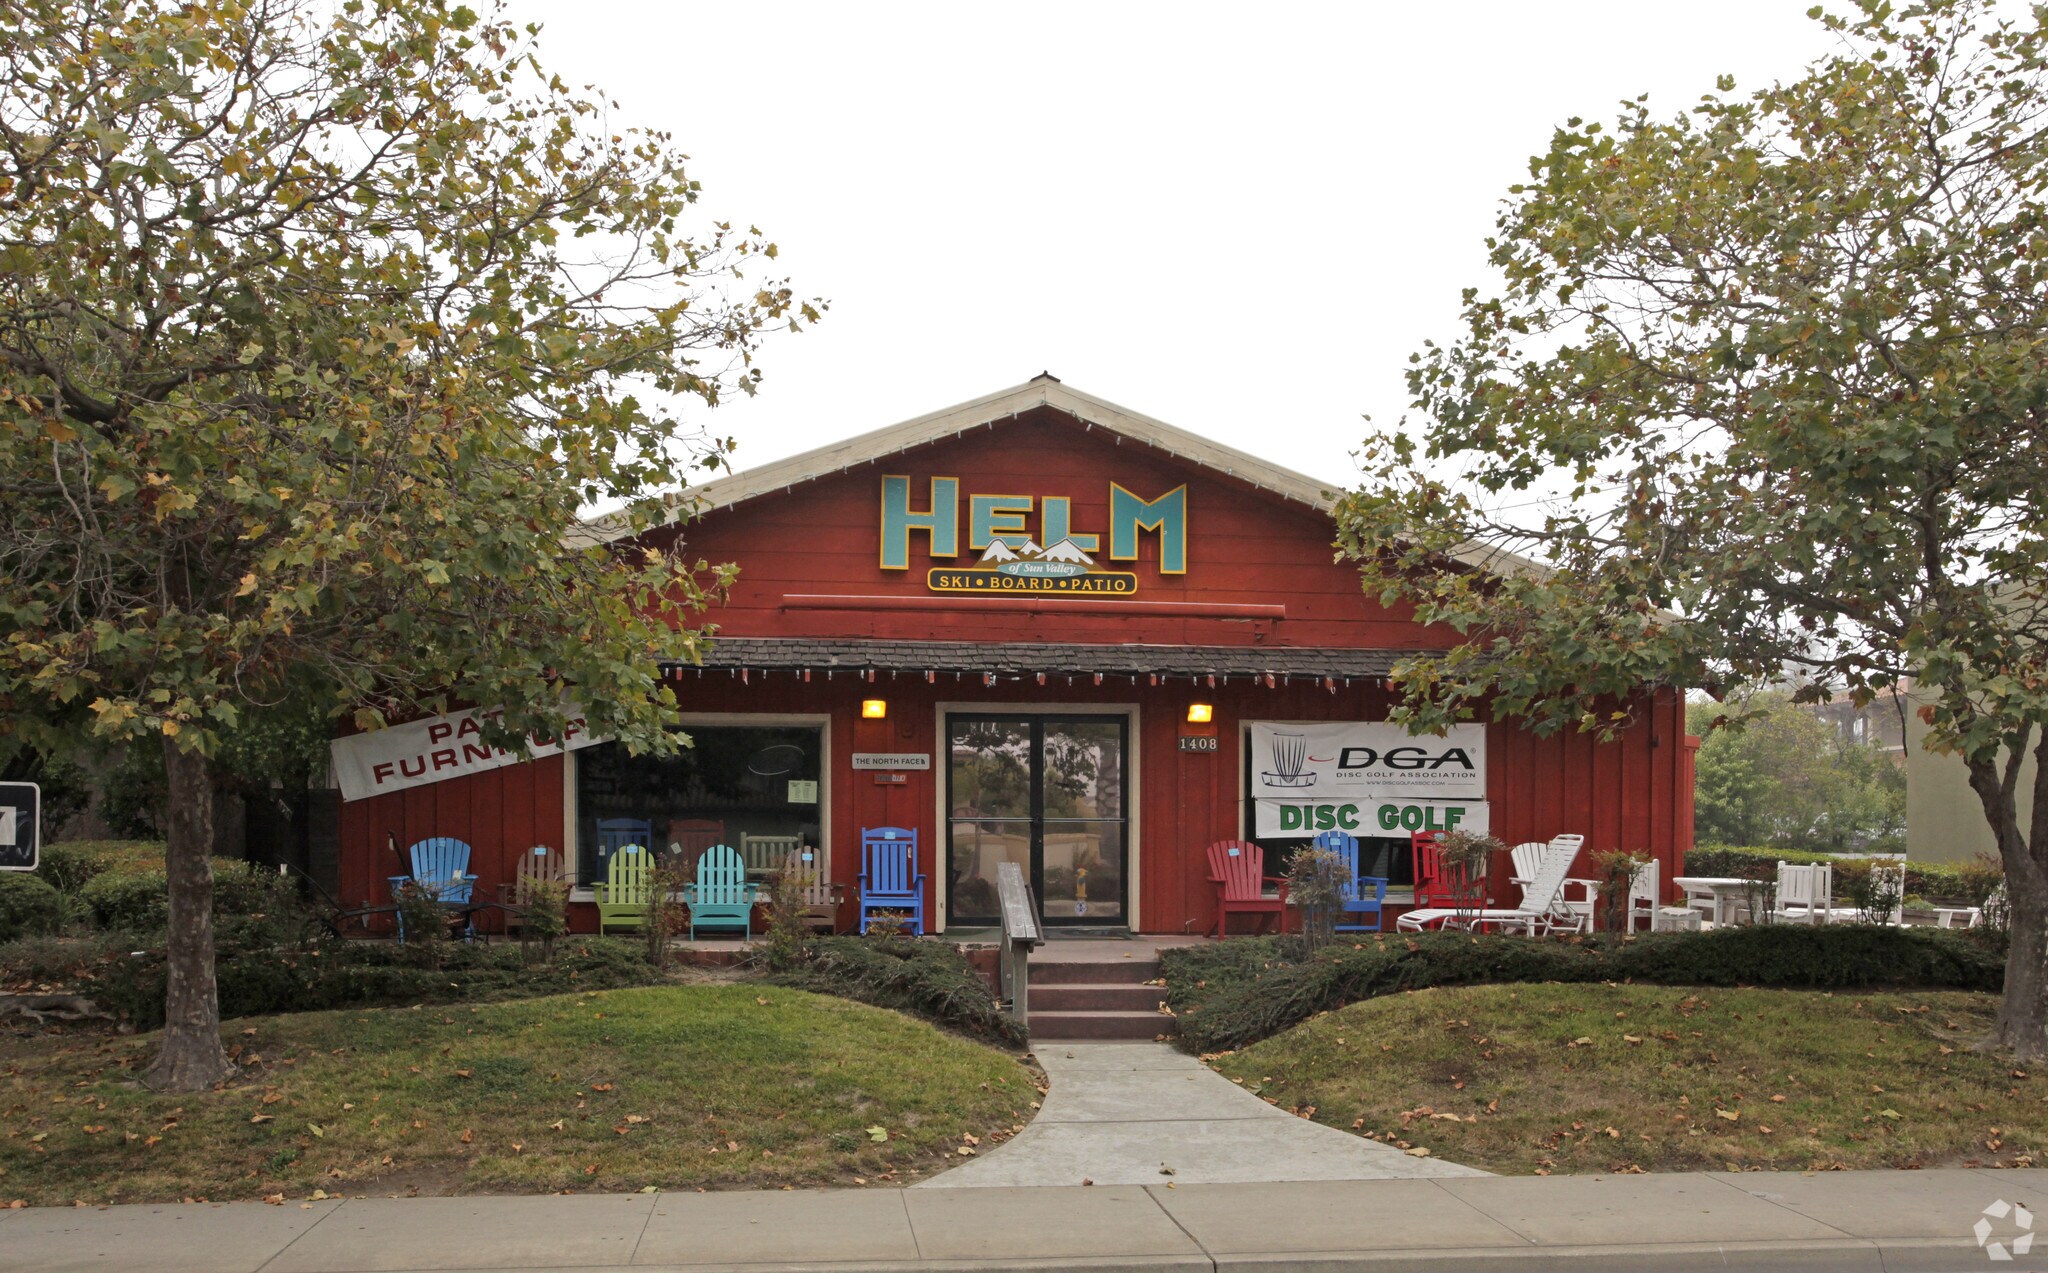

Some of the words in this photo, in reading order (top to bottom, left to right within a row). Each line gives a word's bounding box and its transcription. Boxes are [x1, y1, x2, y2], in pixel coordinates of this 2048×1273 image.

[880, 474, 1187, 575] HELM
[1009, 563, 1020, 574] of
[1024, 563, 1043, 573] Sun
[1046, 564, 1076, 576] Valley
[939, 575, 970, 588] SKI
[990, 576, 1054, 590] BOARD
[1071, 578, 1126, 591] PATIO
[1180, 738, 1217, 750] 1408
[1337, 746, 1475, 770] DGA
[1279, 804, 1360, 831] DISC
[1377, 804, 1466, 832] GOLF
